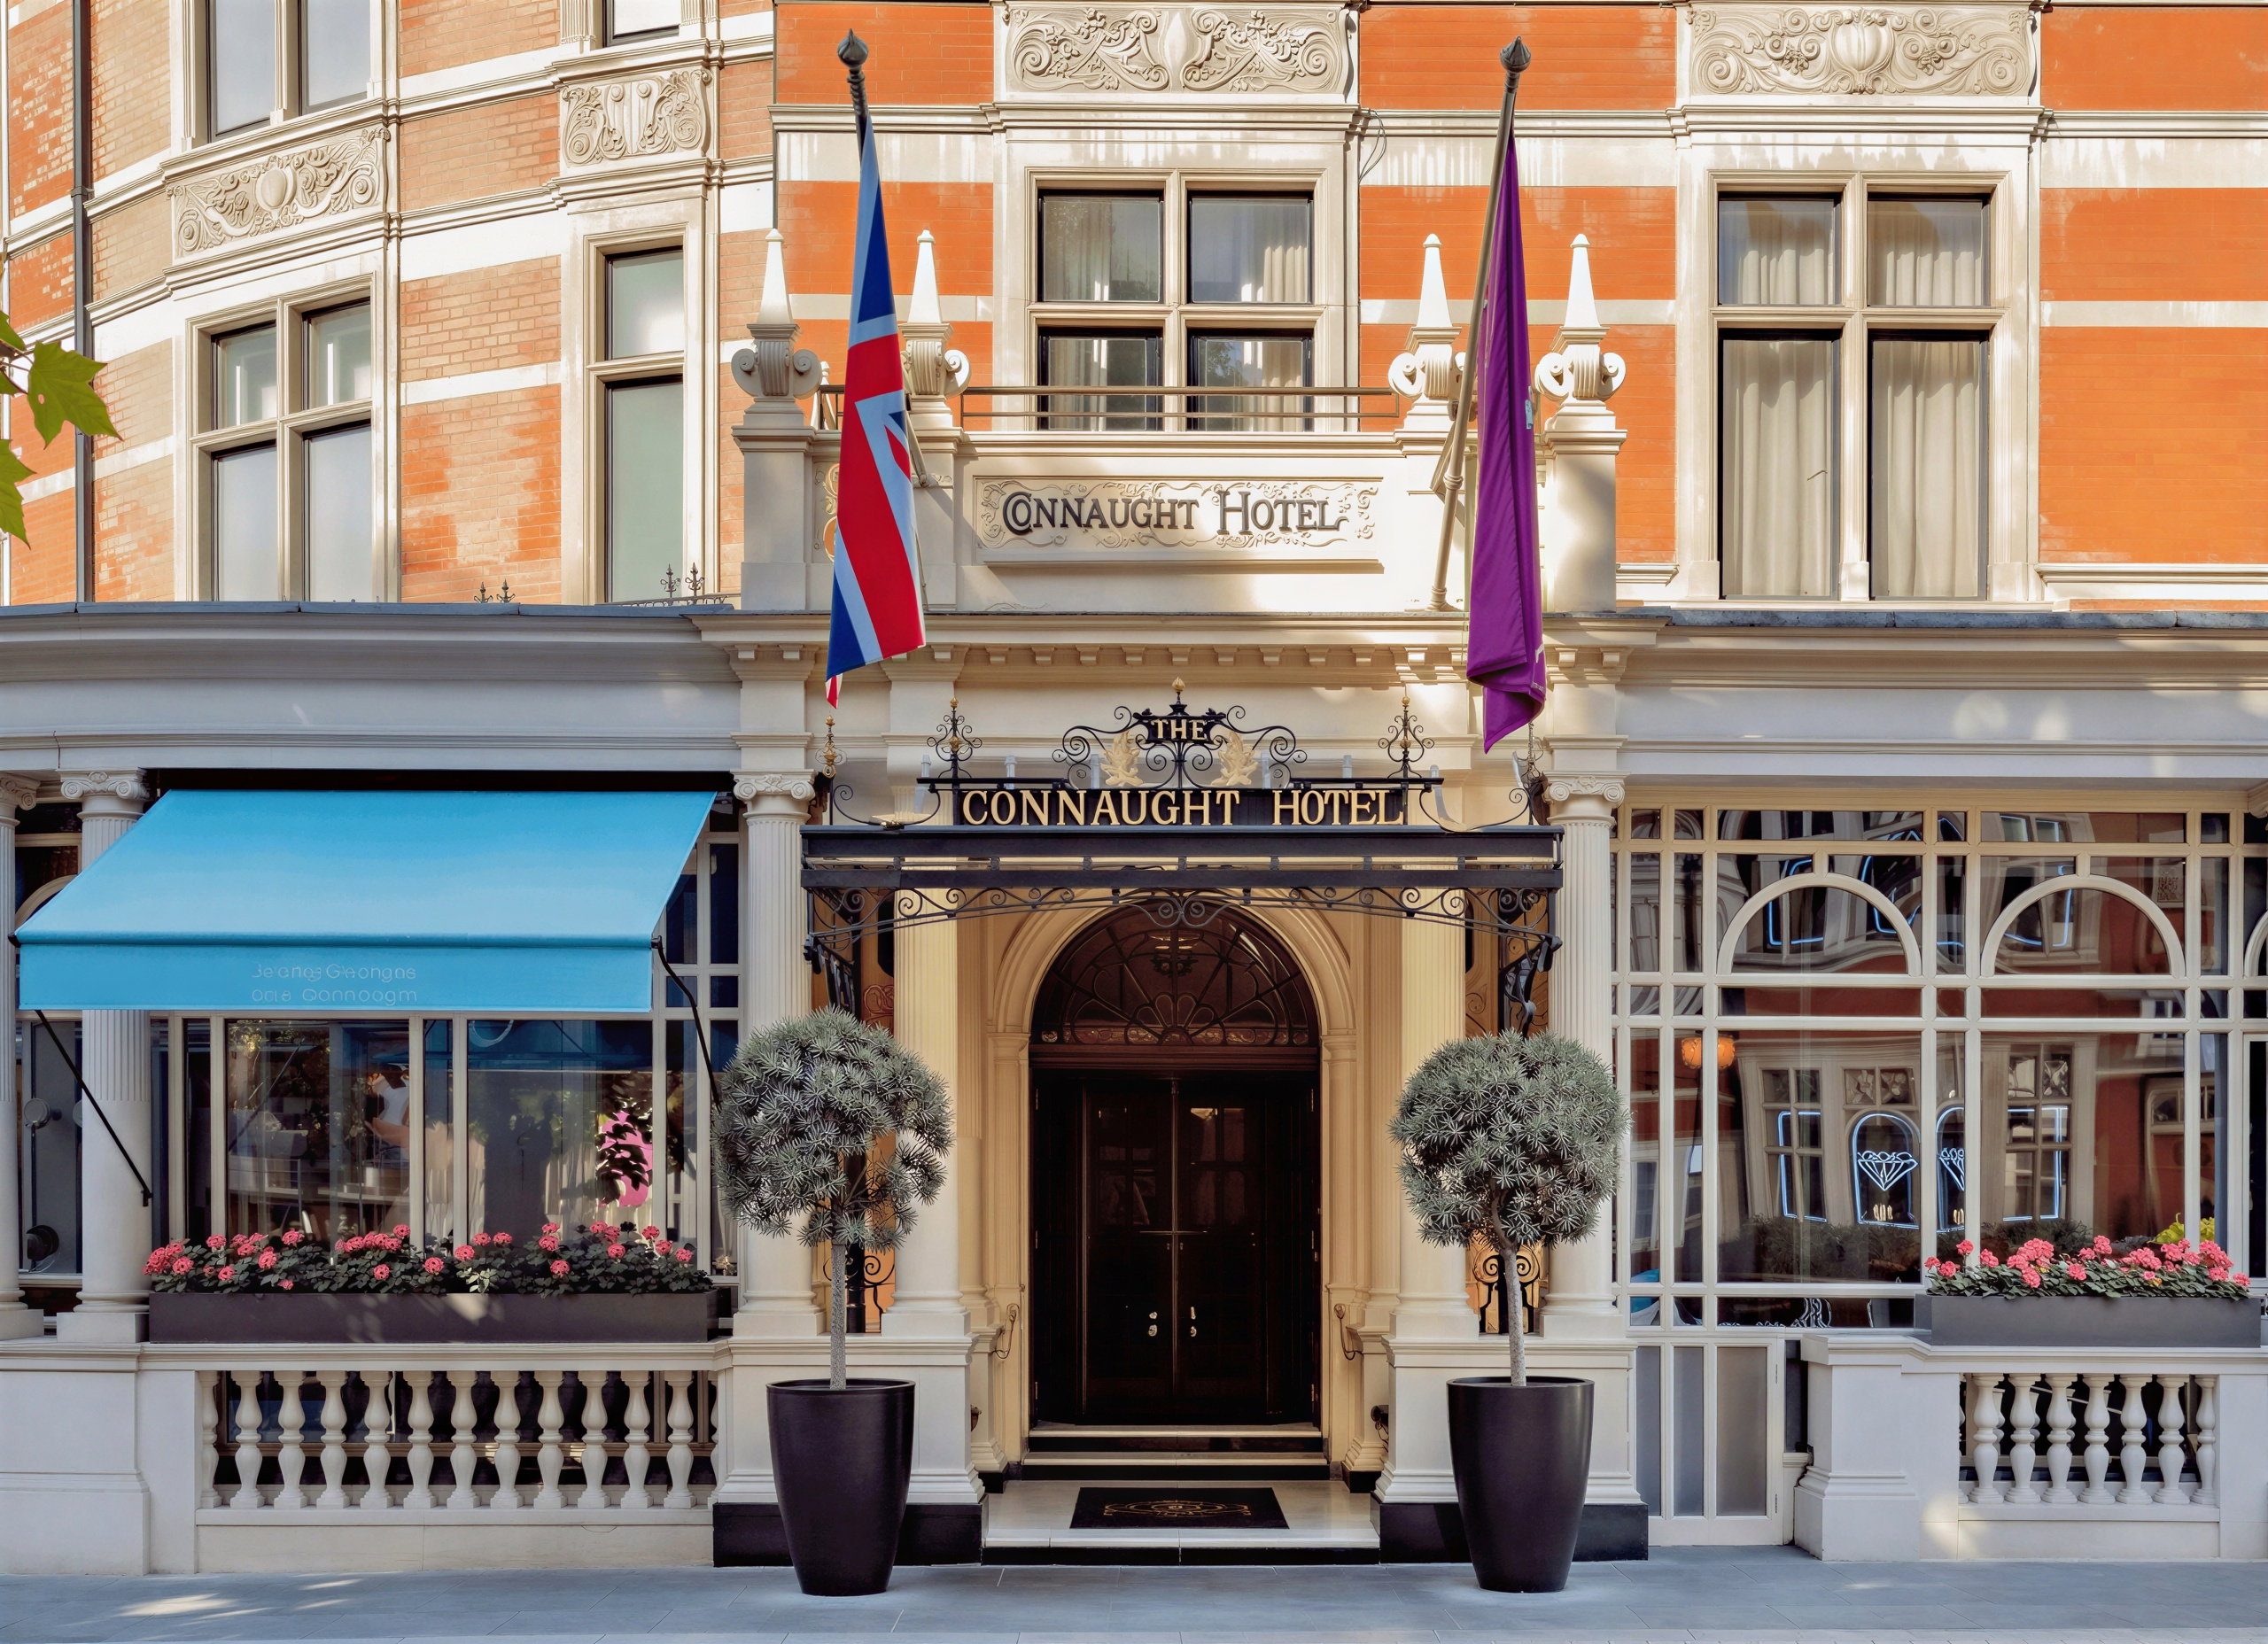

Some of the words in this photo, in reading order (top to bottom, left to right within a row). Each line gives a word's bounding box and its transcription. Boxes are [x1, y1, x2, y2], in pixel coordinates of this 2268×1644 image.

[1003, 492, 1199, 535] CONNAUGHT
[1216, 491, 1350, 535] HOTEL
[1151, 718, 1208, 741] THE
[962, 789, 1240, 826] CONNAUGHT
[1272, 790, 1404, 826] HOTEL
